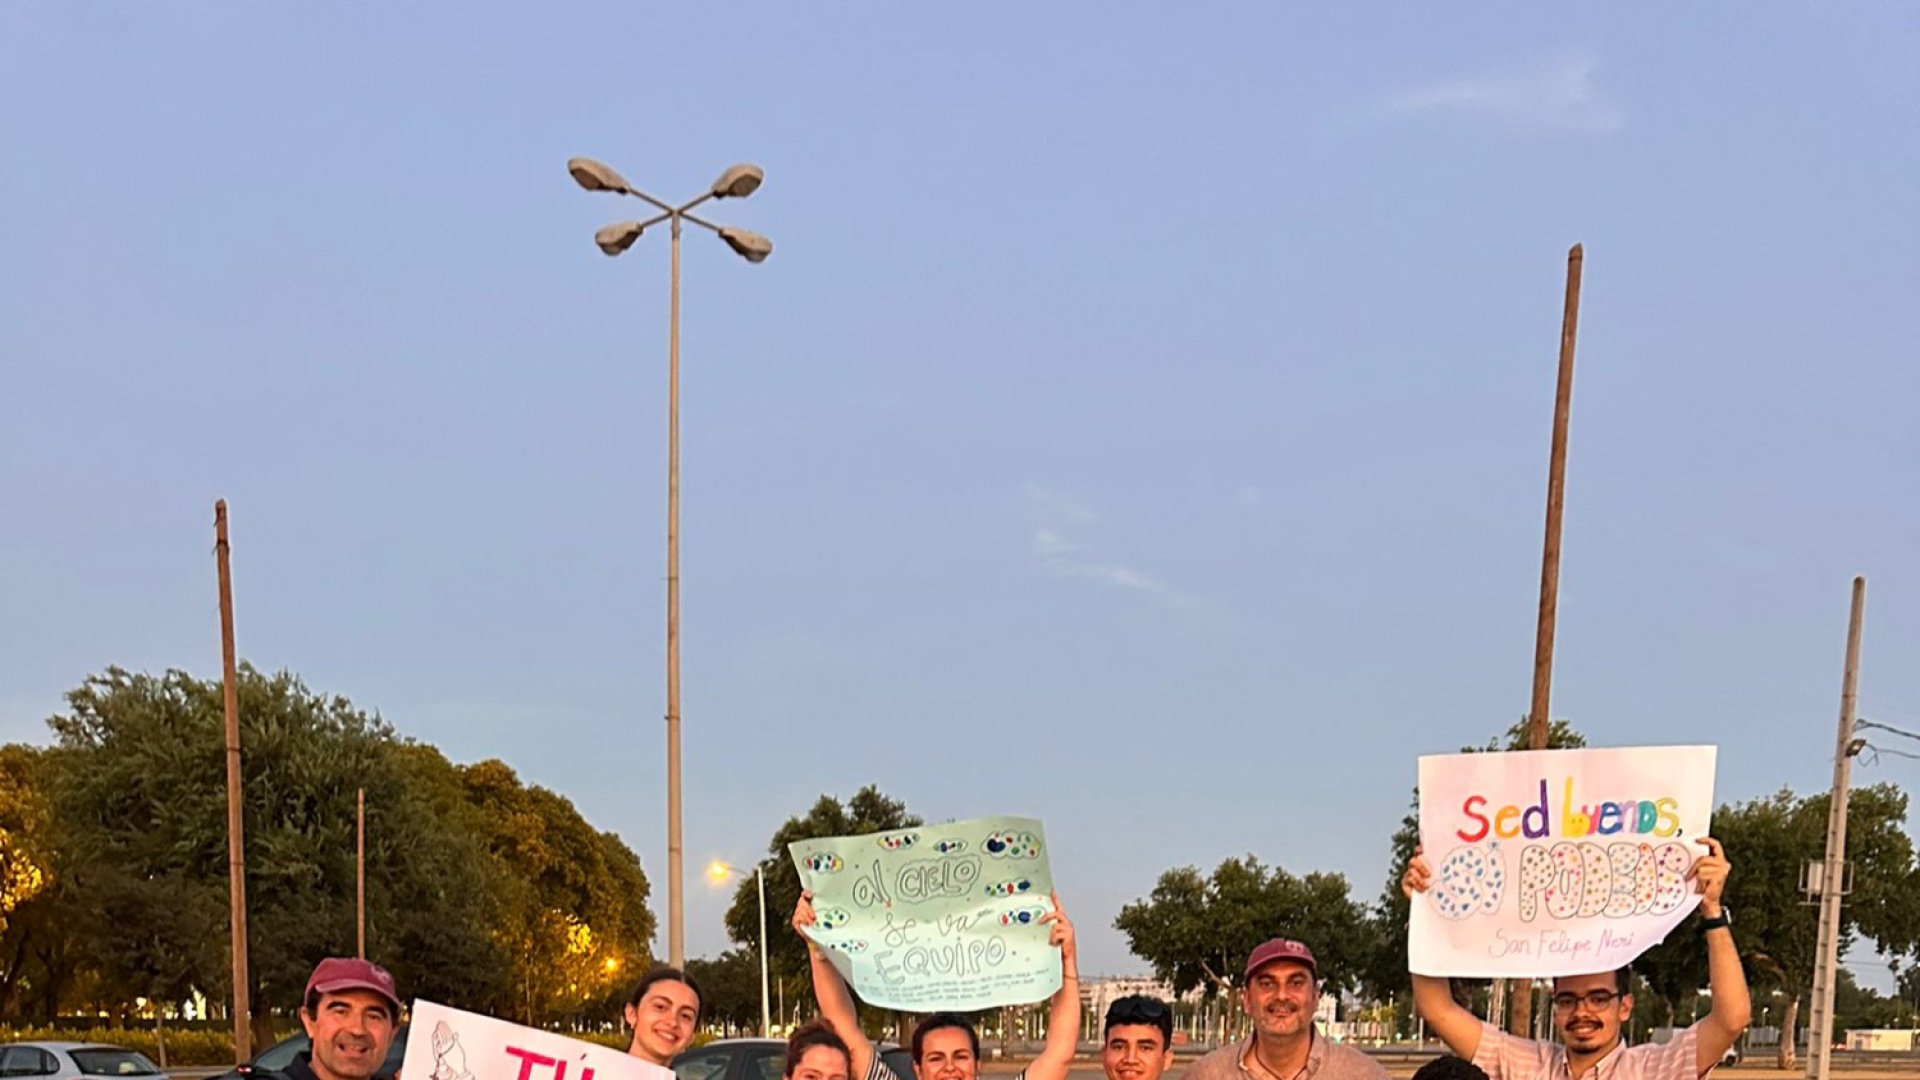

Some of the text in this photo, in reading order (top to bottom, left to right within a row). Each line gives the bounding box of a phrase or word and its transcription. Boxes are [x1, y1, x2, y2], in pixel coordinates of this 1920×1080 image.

[1457, 776, 1683, 842] Sed buenos,
[901, 860, 977, 898] CIELO
[1488, 928, 1634, 960] San Felipe Neri
